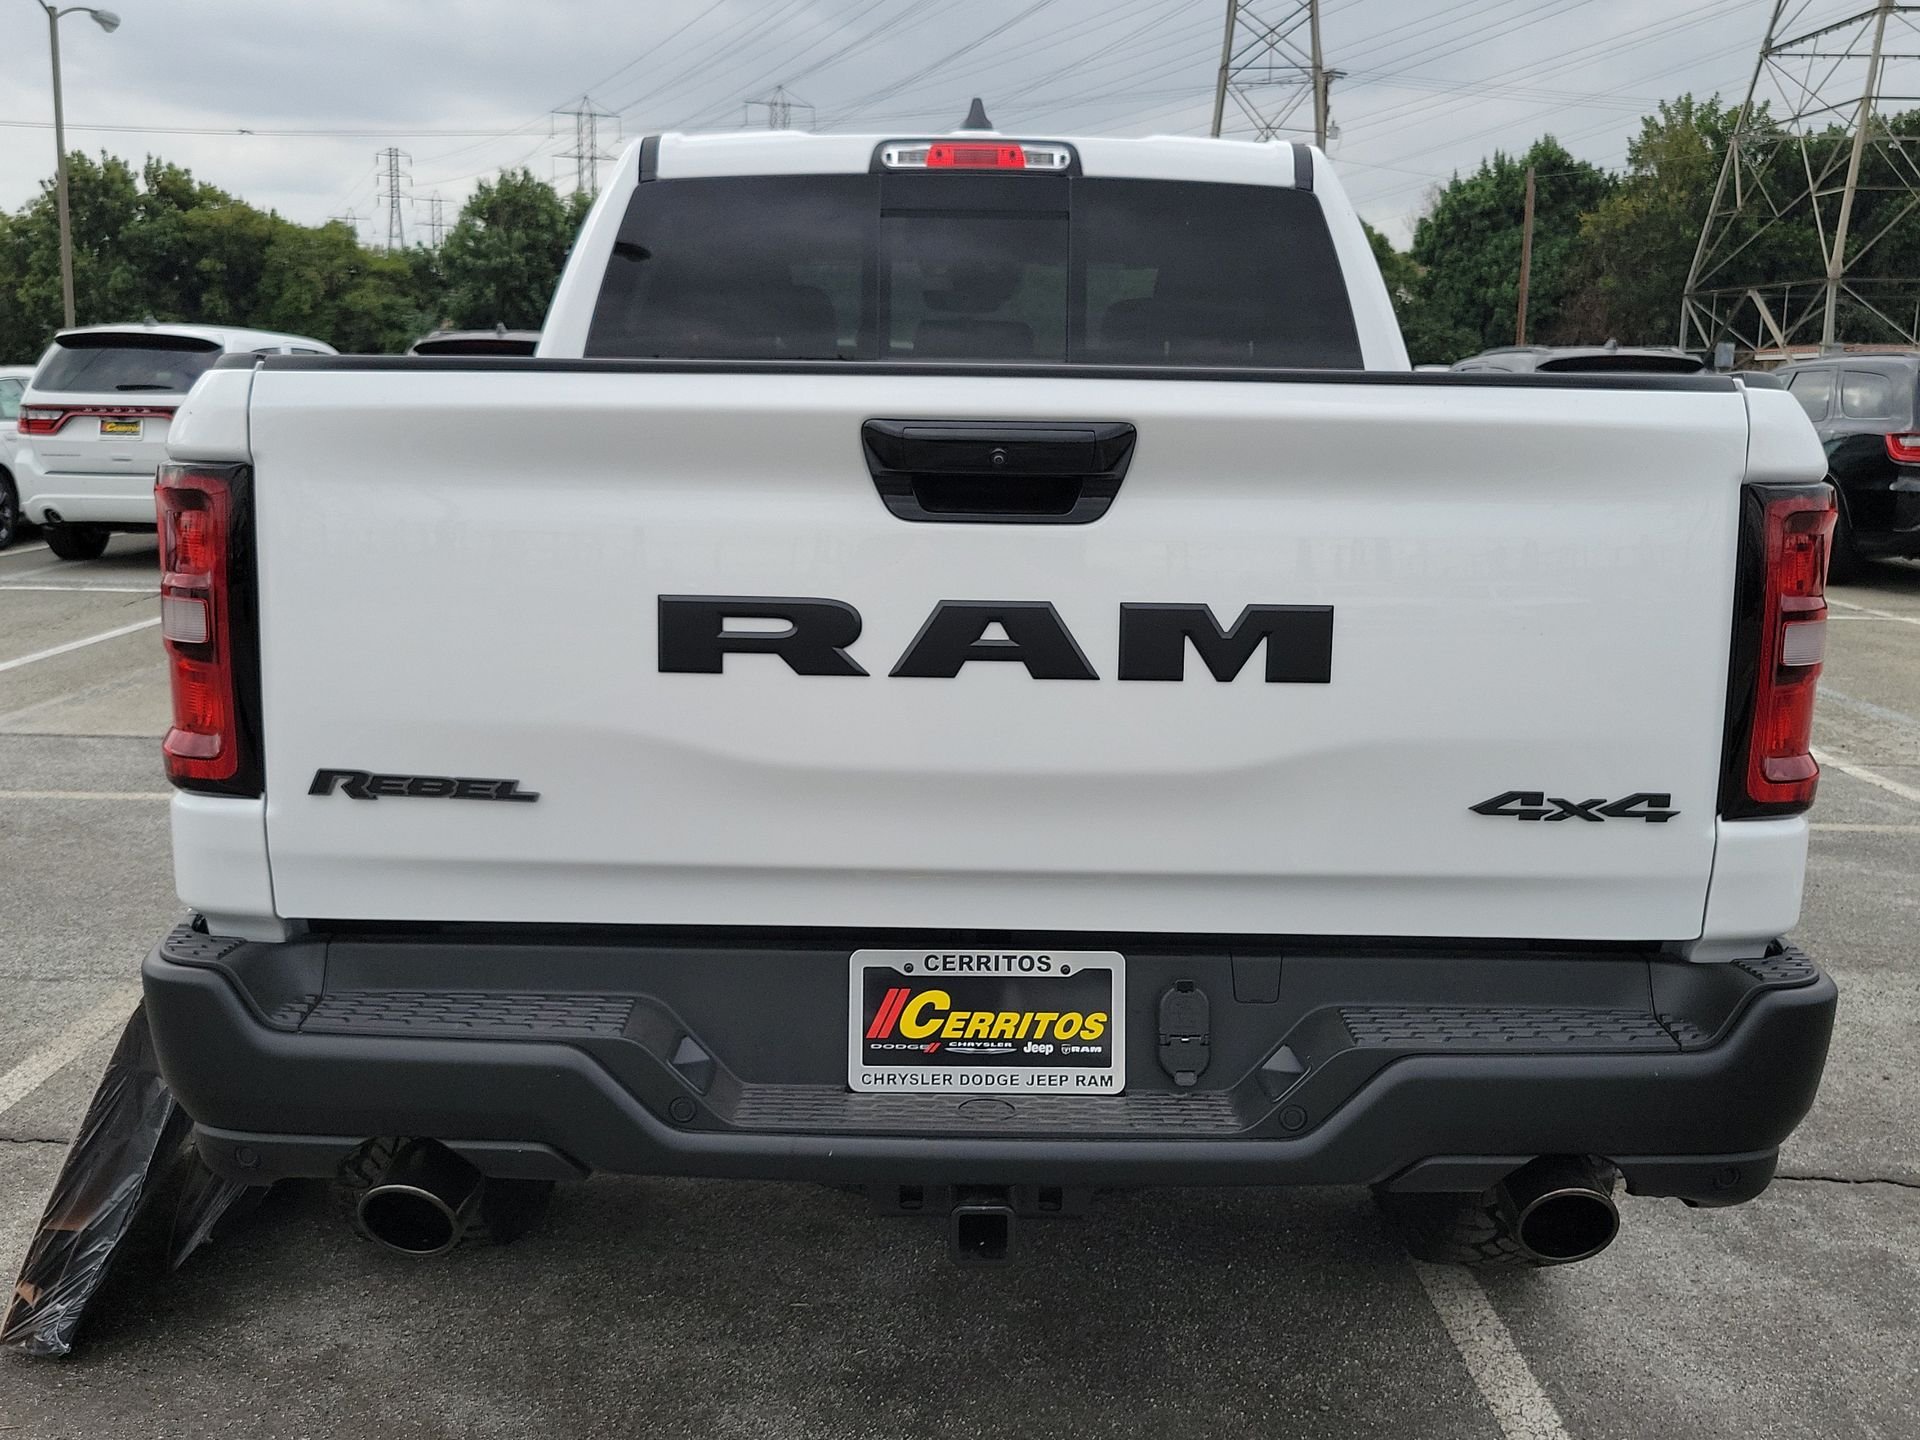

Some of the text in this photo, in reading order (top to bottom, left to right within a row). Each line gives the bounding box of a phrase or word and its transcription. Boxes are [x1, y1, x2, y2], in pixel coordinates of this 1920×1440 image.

[658, 594, 1335, 683] RAM
[308, 768, 541, 802] REBEL
[1468, 790, 1681, 822] 4x4
[924, 954, 1052, 972] CERRITOS
[899, 989, 1108, 1040] CERRITOS
[1023, 1041, 1054, 1056] Jeep
[861, 1073, 1114, 1087] CHRYSLER DODGE JEEP RAM
